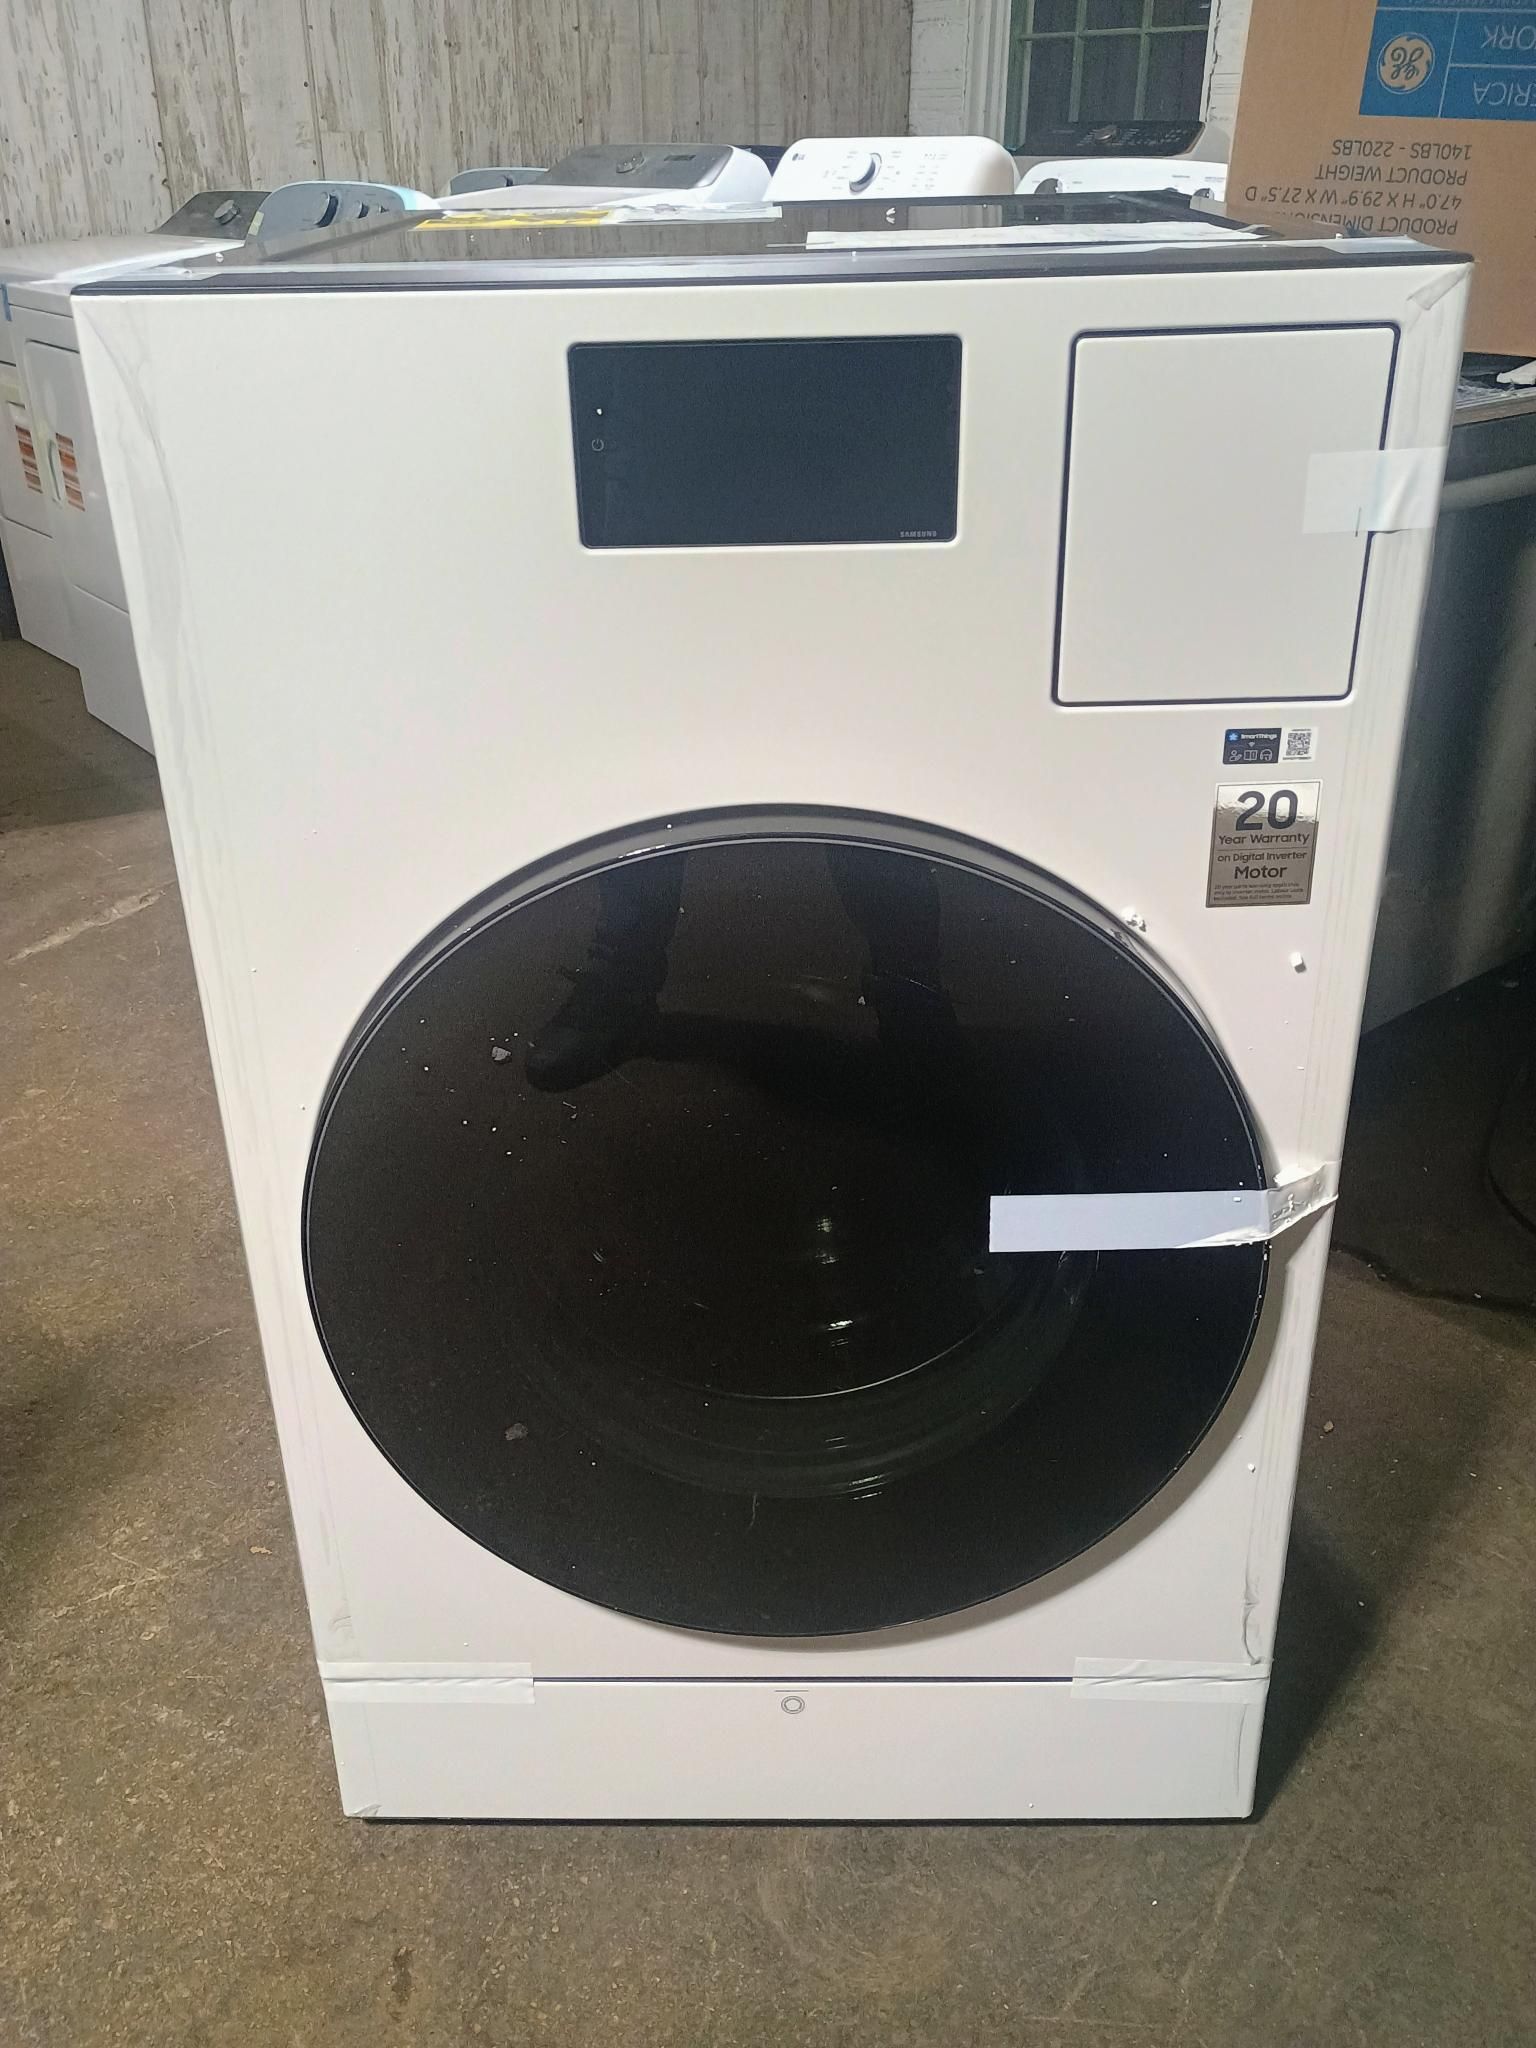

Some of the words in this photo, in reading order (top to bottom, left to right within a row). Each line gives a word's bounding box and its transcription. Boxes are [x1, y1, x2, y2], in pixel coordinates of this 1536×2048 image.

[1480, 25, 1536, 50] ORK
[1331, 139, 1394, 157] 220LBS
[1409, 141, 1472, 161] 140LBS
[1314, 163, 1382, 183] WEIGHT
[1385, 166, 1468, 187] PRODUCT
[1244, 185, 1257, 202] D
[1305, 188, 1318, 204] X
[1321, 188, 1338, 206] W
[1387, 192, 1399, 208] X
[1402, 193, 1416, 209] H
[1378, 215, 1458, 235] PRODUCT
[900, 530, 937, 538] SAMSUNG
[1235, 789, 1299, 831] 20
[1218, 835, 1247, 845] Year
[1249, 833, 1310, 845] Warranty
[1217, 854, 1231, 862] on
[1233, 852, 1265, 864] Digital
[1266, 851, 1308, 861] Inverter
[1234, 865, 1288, 880] Motor
